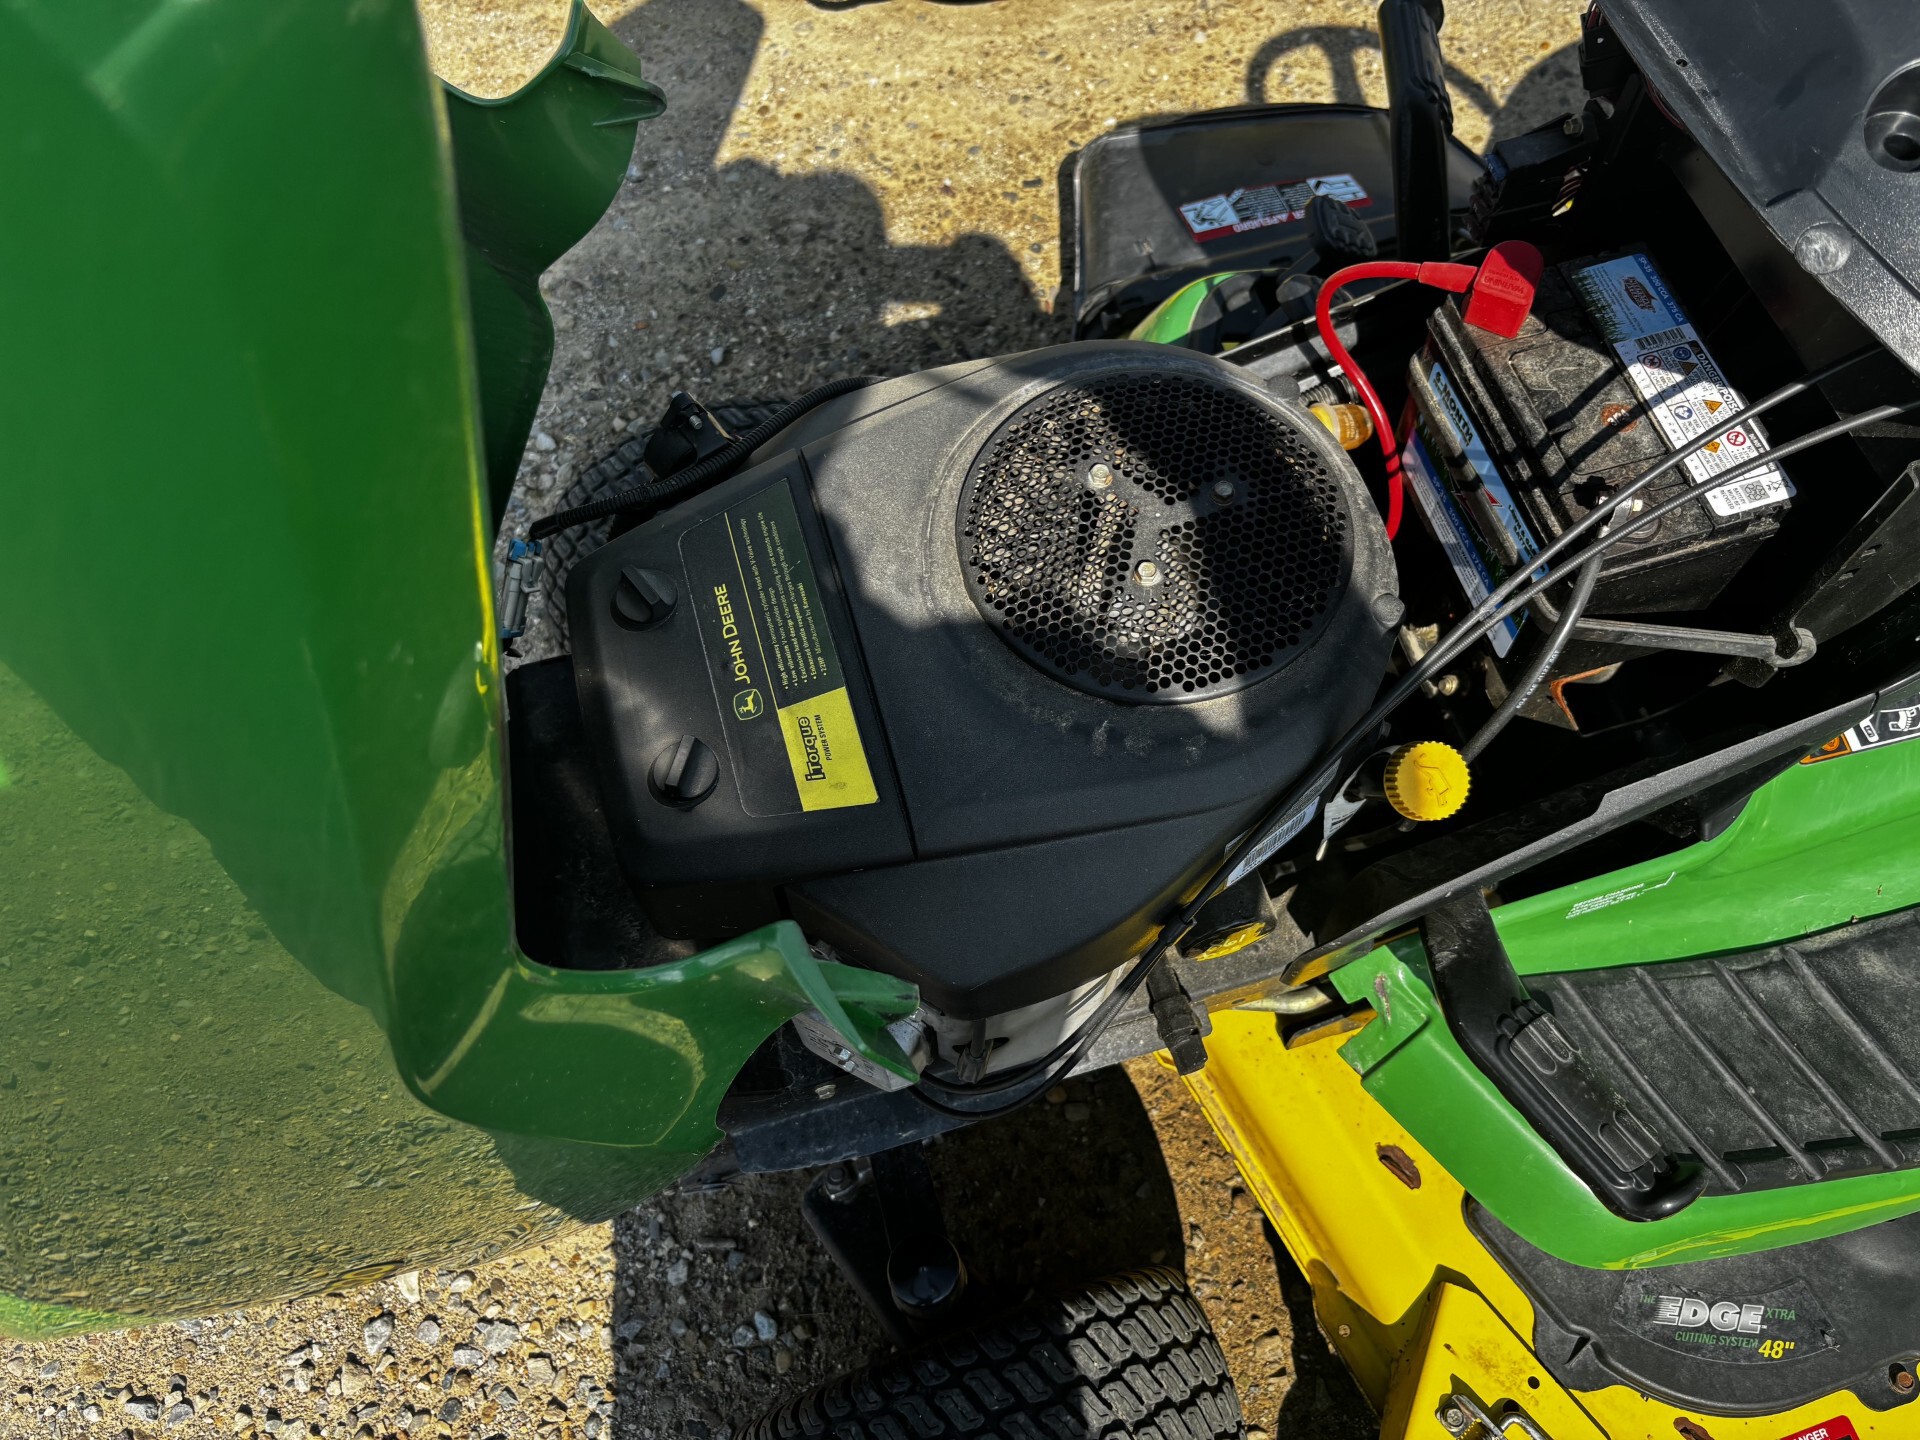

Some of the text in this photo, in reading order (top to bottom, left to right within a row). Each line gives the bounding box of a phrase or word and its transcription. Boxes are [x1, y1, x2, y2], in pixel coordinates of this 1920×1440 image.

[1657, 285, 1669, 299] CCA
[1666, 299, 1678, 313] 375
[1674, 311, 1684, 322] CA
[1479, 571, 1491, 587] CA
[797, 582, 809, 608] Kawasaki
[713, 583, 750, 683] JOHN DEERE
[786, 618, 797, 637] design
[817, 655, 827, 671] 22HP
[796, 715, 826, 783] iTorque
[814, 714, 832, 761] POWER SYSTEM
[1639, 1294, 1796, 1334] THE EDGE XTRA
[1675, 1330, 1795, 1360] CUTTING SYSTEM 48"
[1792, 1427, 1829, 1440] NGER
